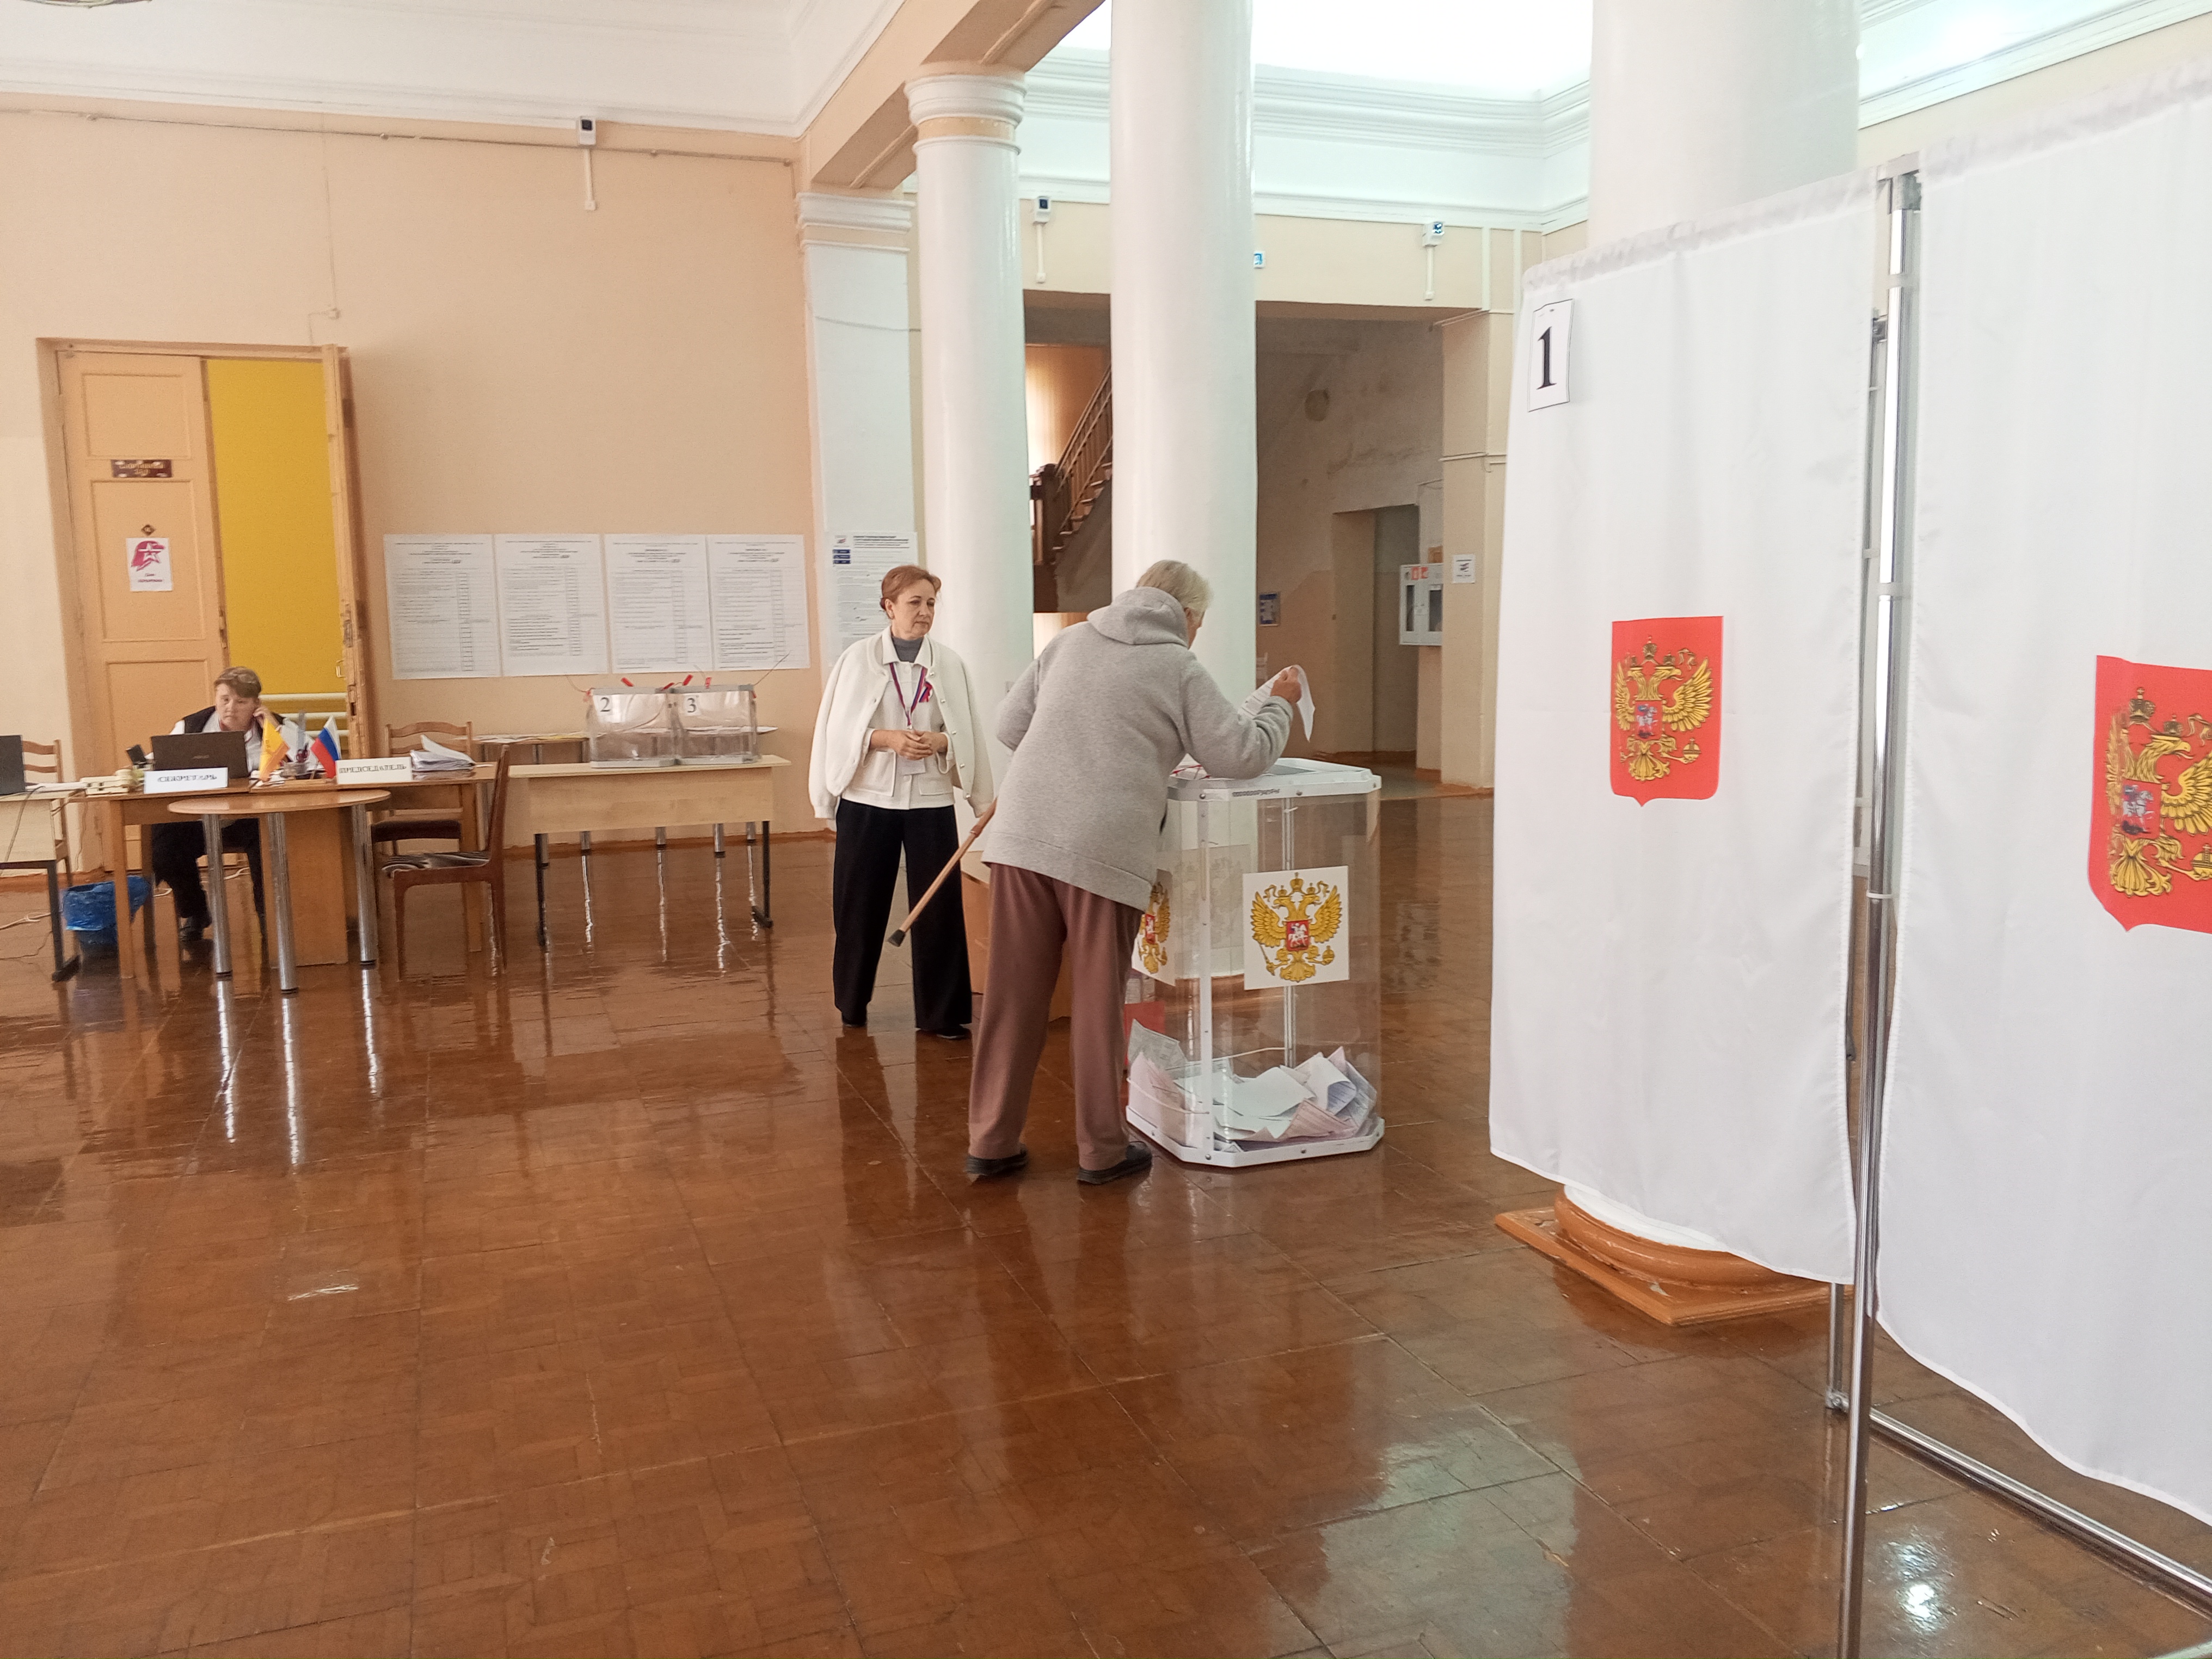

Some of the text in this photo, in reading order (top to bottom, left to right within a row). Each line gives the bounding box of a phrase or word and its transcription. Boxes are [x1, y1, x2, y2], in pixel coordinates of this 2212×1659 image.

[1537, 327, 1557, 390] 1
[600, 697, 611, 712] 2
[687, 697, 697, 713] 3
